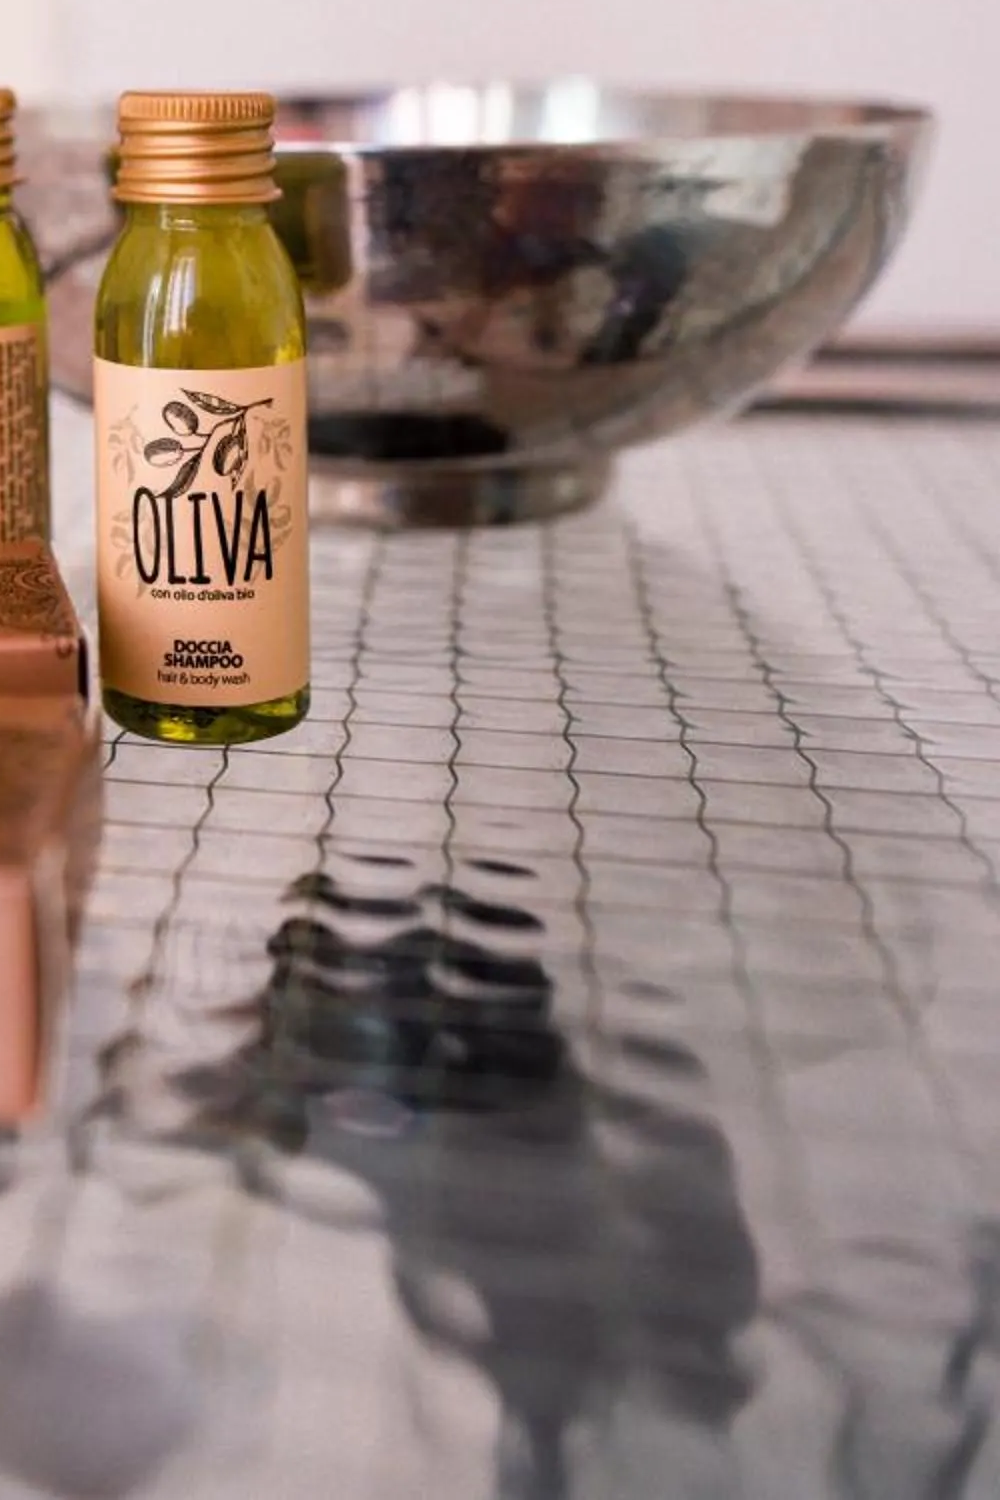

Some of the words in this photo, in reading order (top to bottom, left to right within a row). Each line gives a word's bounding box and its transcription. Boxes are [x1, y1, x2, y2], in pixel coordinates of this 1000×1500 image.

[133, 486, 273, 586] OLIVA
[150, 587, 171, 599] con
[173, 588, 195, 601] olio
[197, 588, 235, 601] d'oliva
[235, 587, 255, 600] bio
[173, 639, 233, 654] DOCCIA
[163, 652, 244, 669] SHAMPOO
[157, 668, 177, 683] hair
[180, 672, 188, 685] &
[190, 671, 220, 689] body
[221, 671, 251, 685] wash
